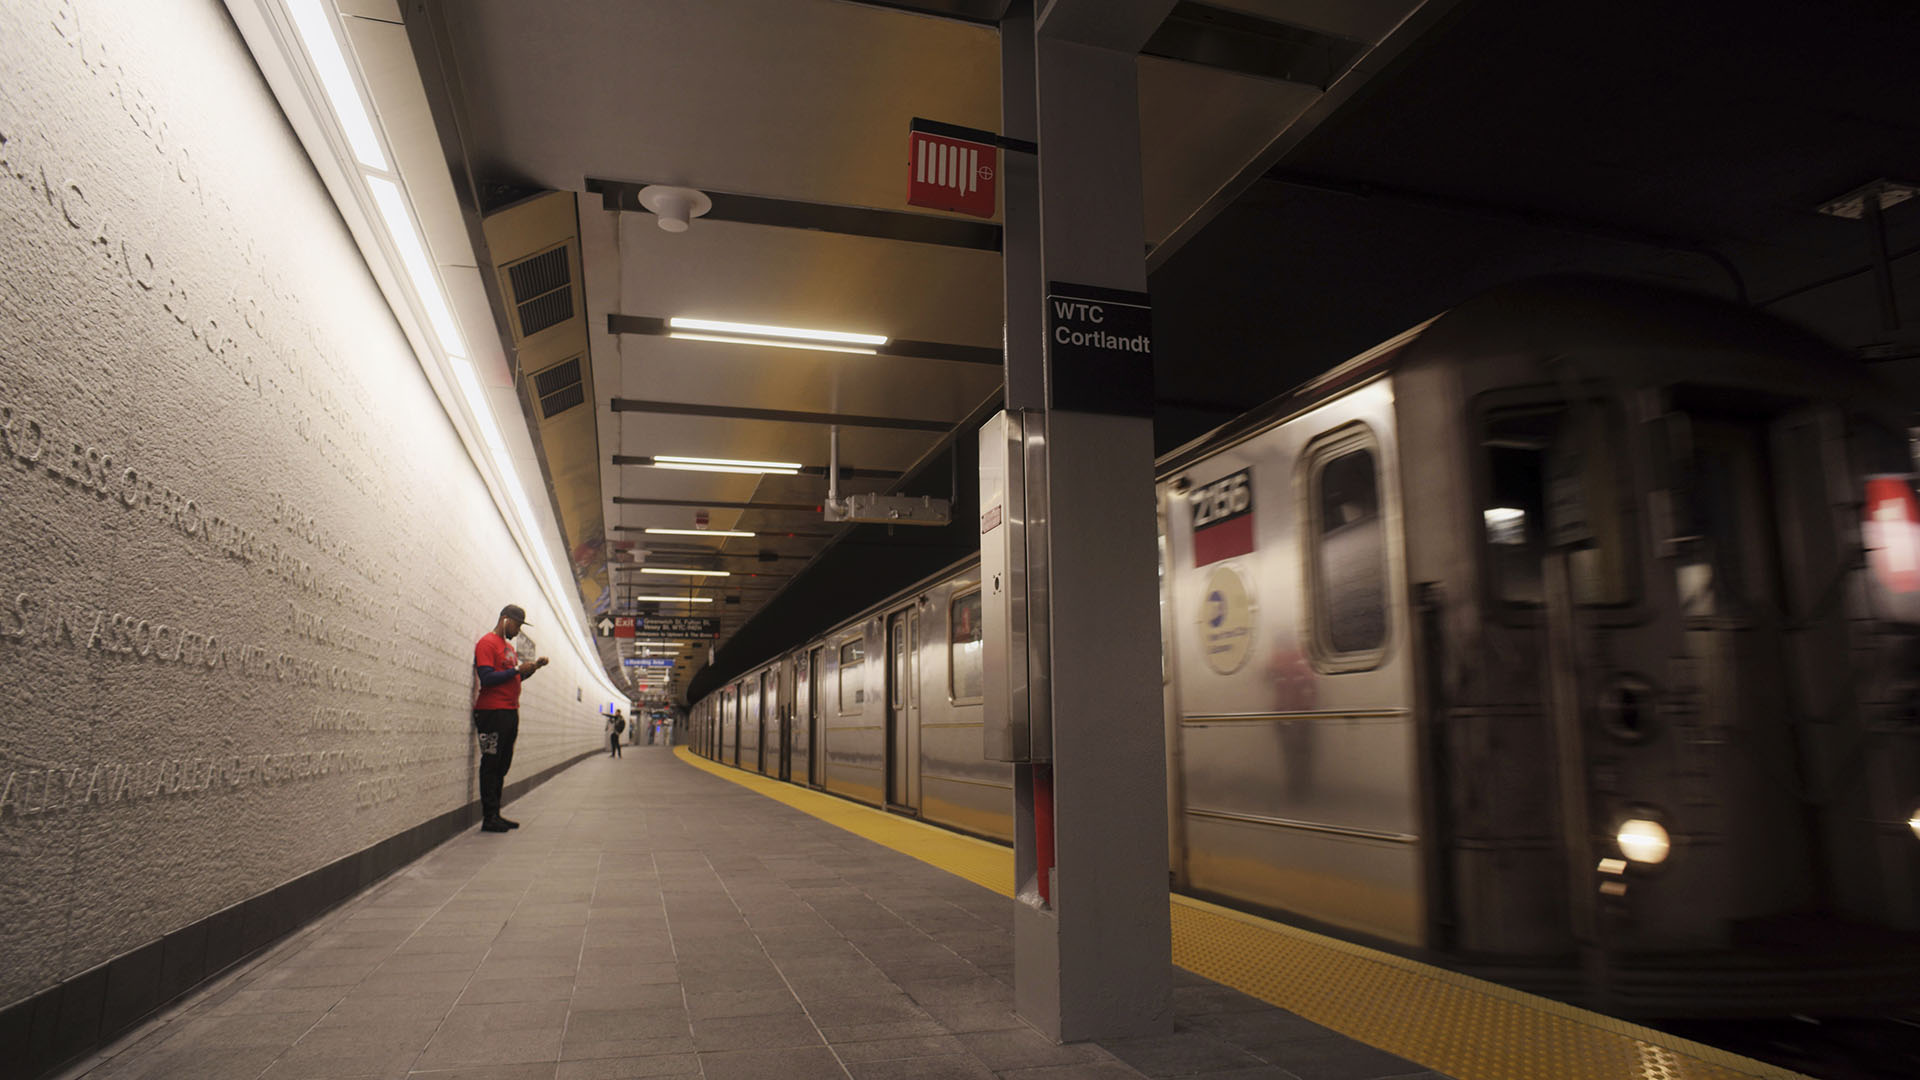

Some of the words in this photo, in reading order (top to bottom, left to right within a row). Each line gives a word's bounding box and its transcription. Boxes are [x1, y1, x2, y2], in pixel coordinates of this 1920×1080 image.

[1055, 300, 1104, 323] WTC
[1055, 326, 1151, 353] Cortlandt
[615, 618, 634, 627] Exit
